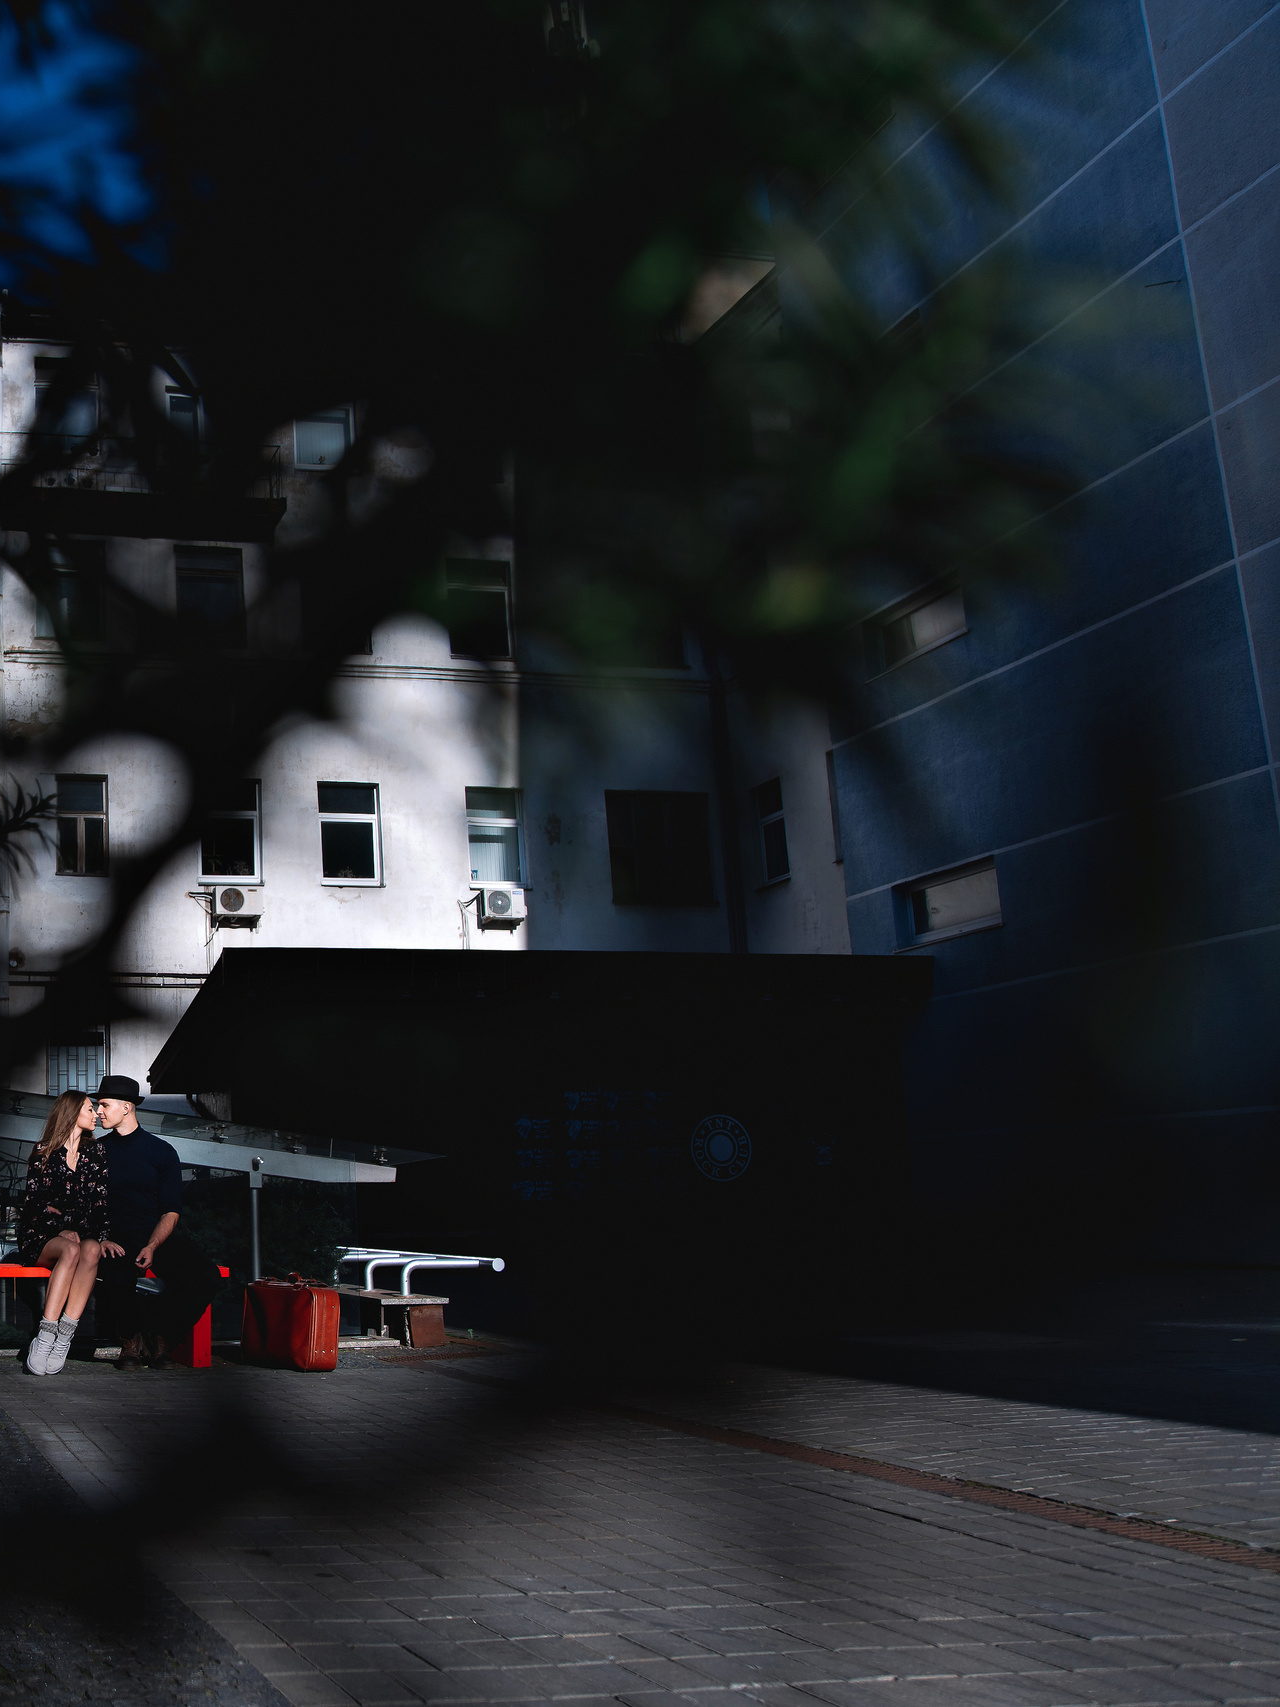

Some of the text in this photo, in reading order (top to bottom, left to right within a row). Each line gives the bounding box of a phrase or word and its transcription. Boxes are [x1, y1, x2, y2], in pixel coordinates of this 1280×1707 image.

[694, 1118, 748, 1177] TNT ROCK CLUB
